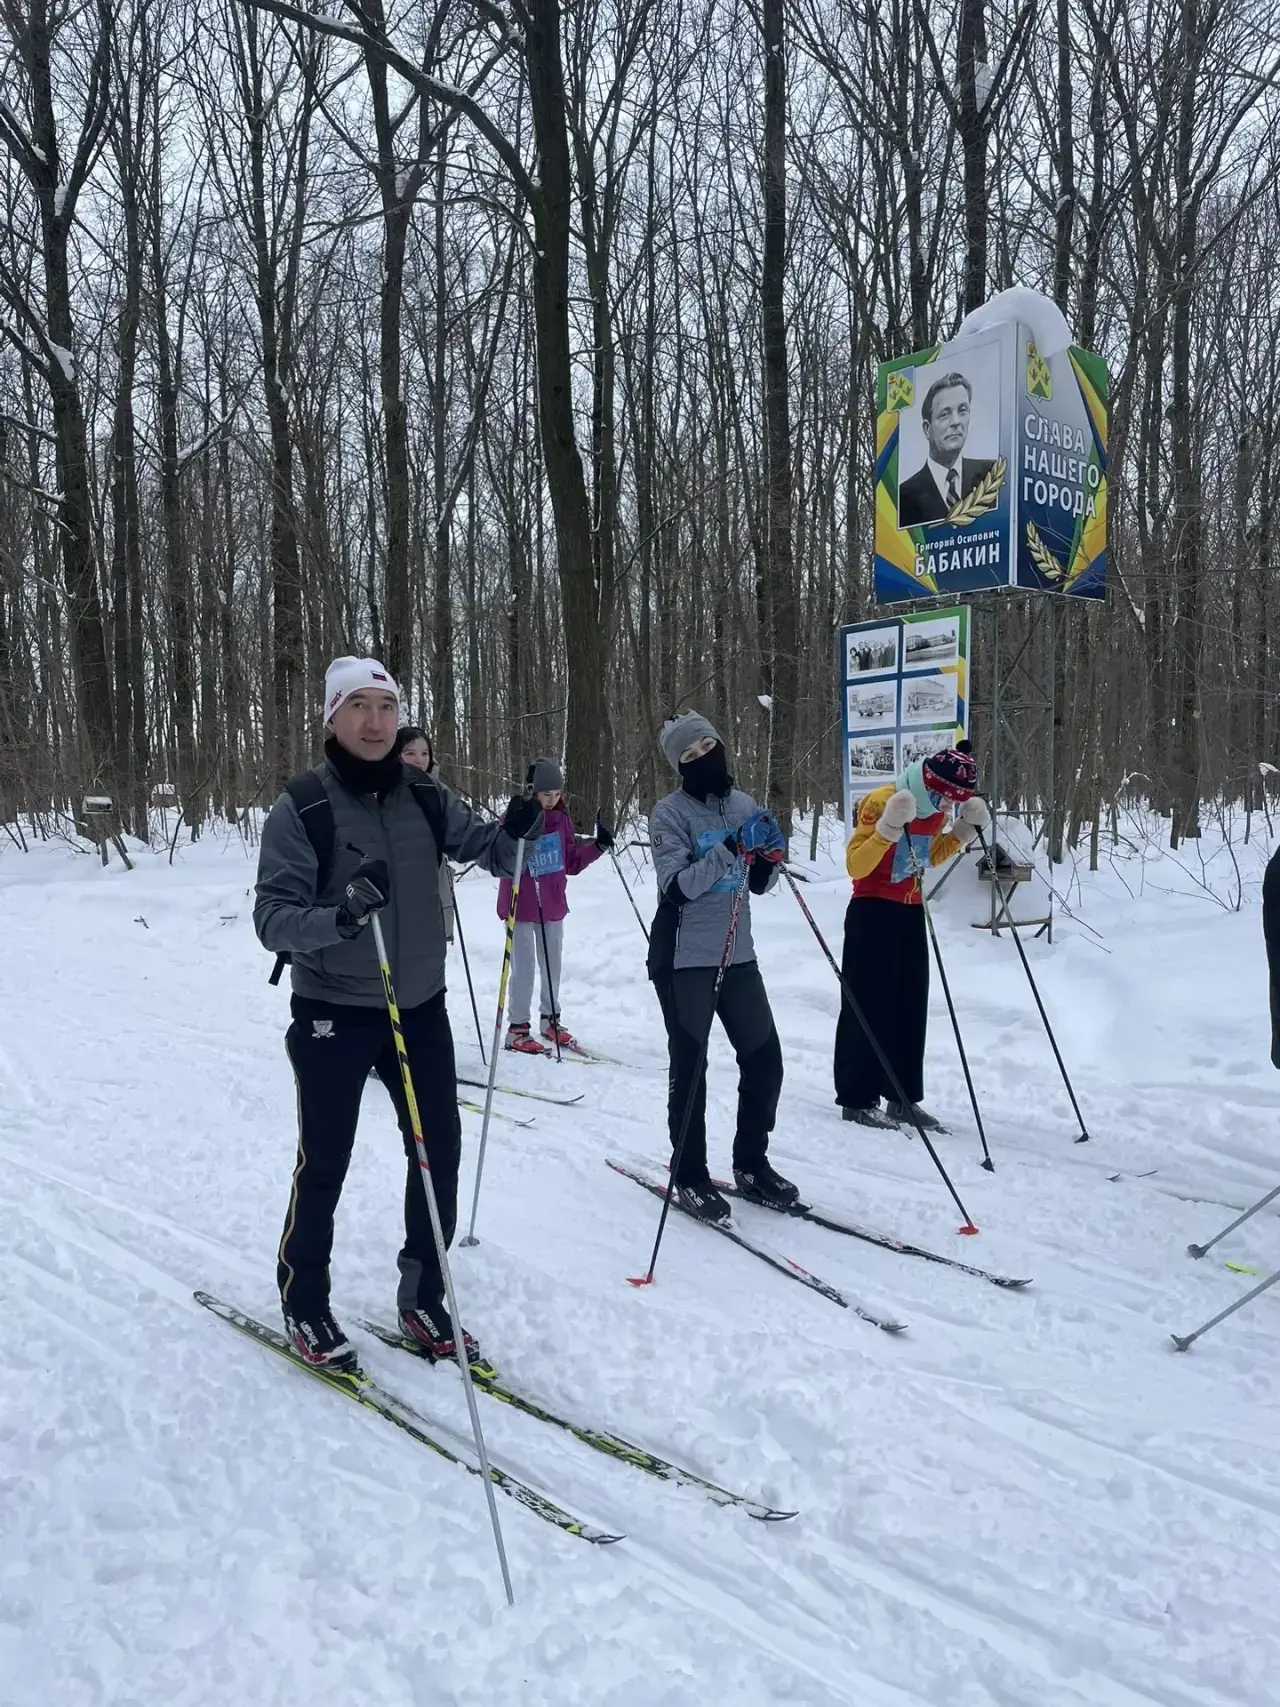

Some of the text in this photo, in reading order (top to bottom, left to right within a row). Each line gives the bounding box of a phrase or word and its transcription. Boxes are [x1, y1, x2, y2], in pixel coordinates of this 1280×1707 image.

[1024, 413, 1085, 455] СЛАВА
[1024, 444, 1100, 488] НАШЕГО
[1023, 476, 1096, 520] ГОРОДА
[915, 529, 1000, 553] Григорий Осипович
[915, 542, 1000, 577] БАБАКИН
[414, 1309, 440, 1338] ADSHUS
